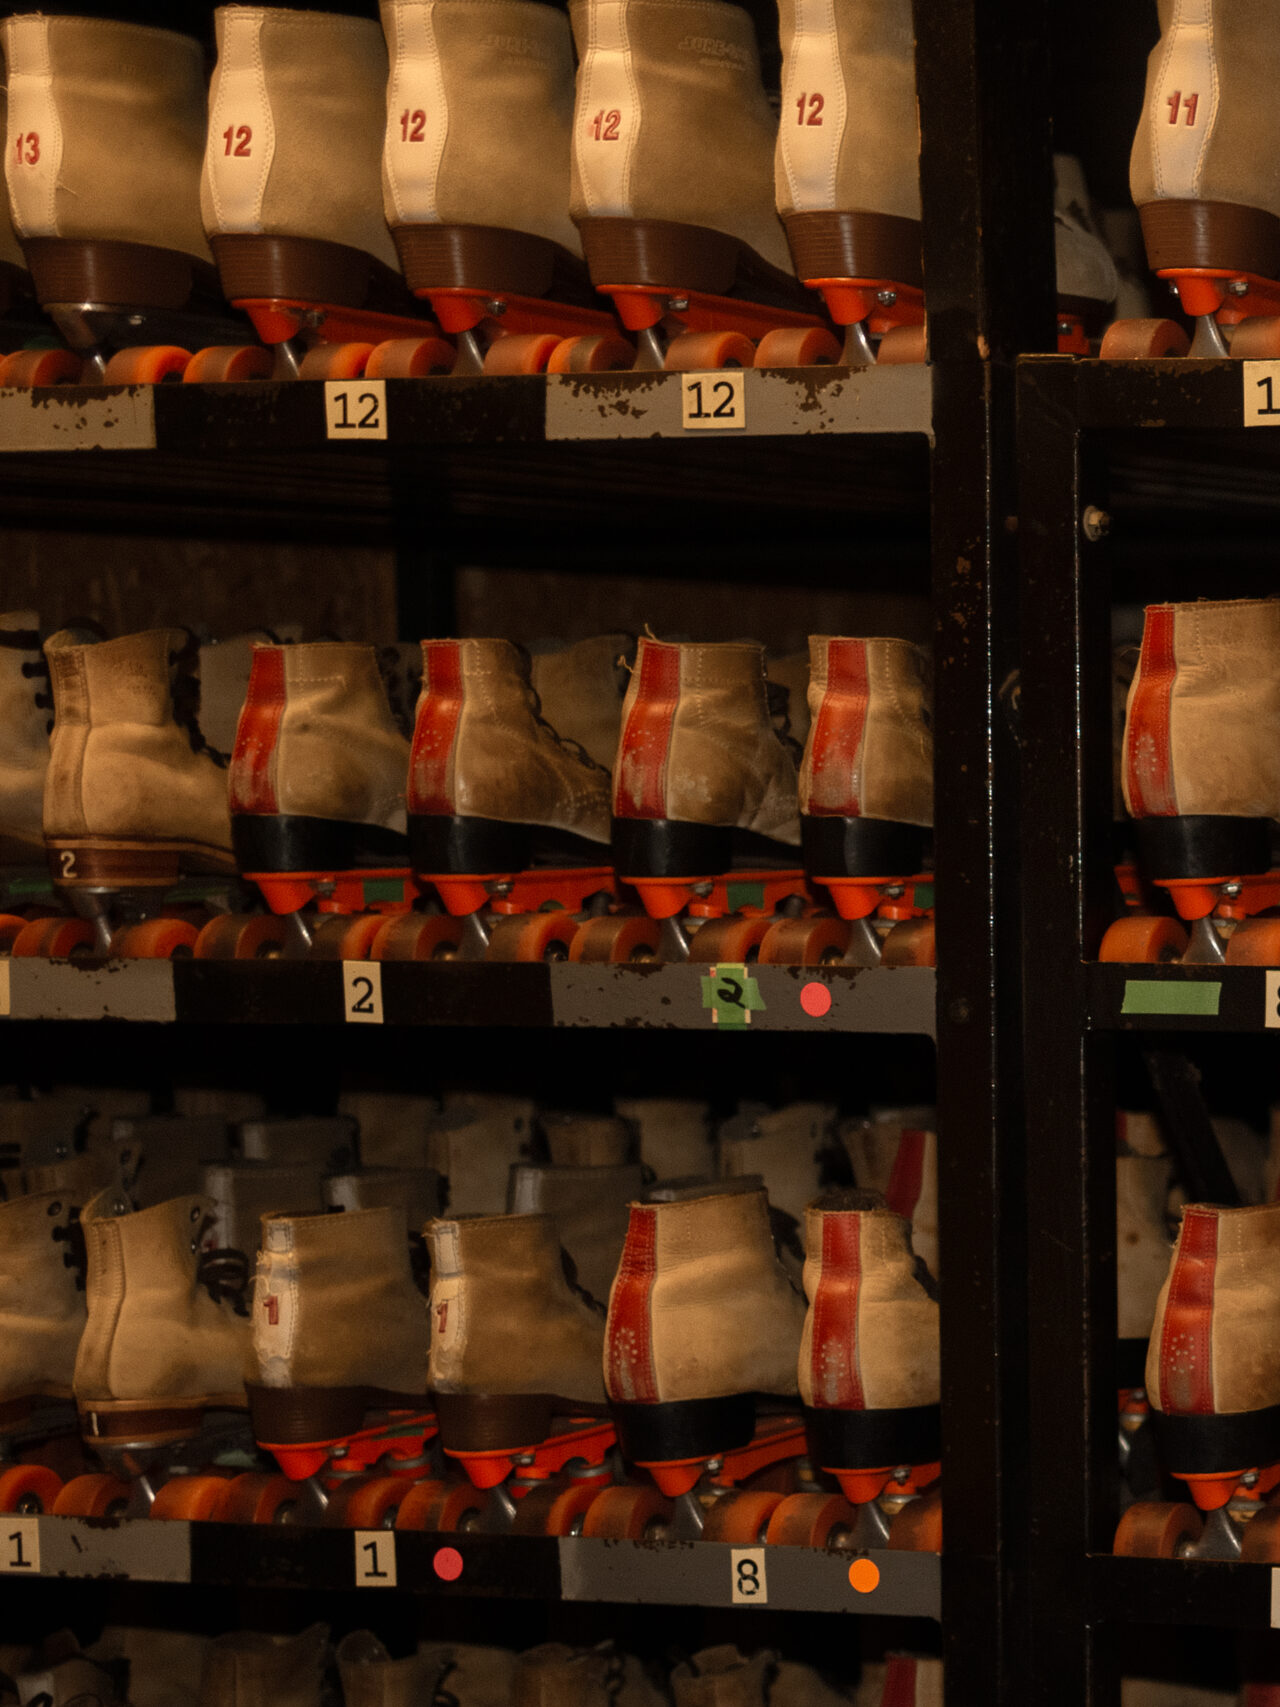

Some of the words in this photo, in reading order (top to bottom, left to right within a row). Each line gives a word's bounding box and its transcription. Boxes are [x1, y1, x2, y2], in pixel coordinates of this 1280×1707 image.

[400, 109, 427, 142] 12
[592, 109, 621, 141] 12
[796, 93, 825, 126] 12
[1167, 91, 1199, 127] 11
[15, 132, 41, 165] 13
[223, 125, 252, 157] 12
[334, 393, 379, 428] 12
[687, 381, 735, 418] 12
[60, 850, 77, 879] 2
[351, 976, 375, 1014] 2
[717, 977, 746, 1009] 2
[263, 1295, 279, 1326] 1
[435, 1303, 449, 1334] 1
[1169, 1332, 1197, 1375] 8
[8, 1531, 32, 1568] 1
[362, 1540, 388, 1578] 1
[736, 1558, 760, 1596] 8
